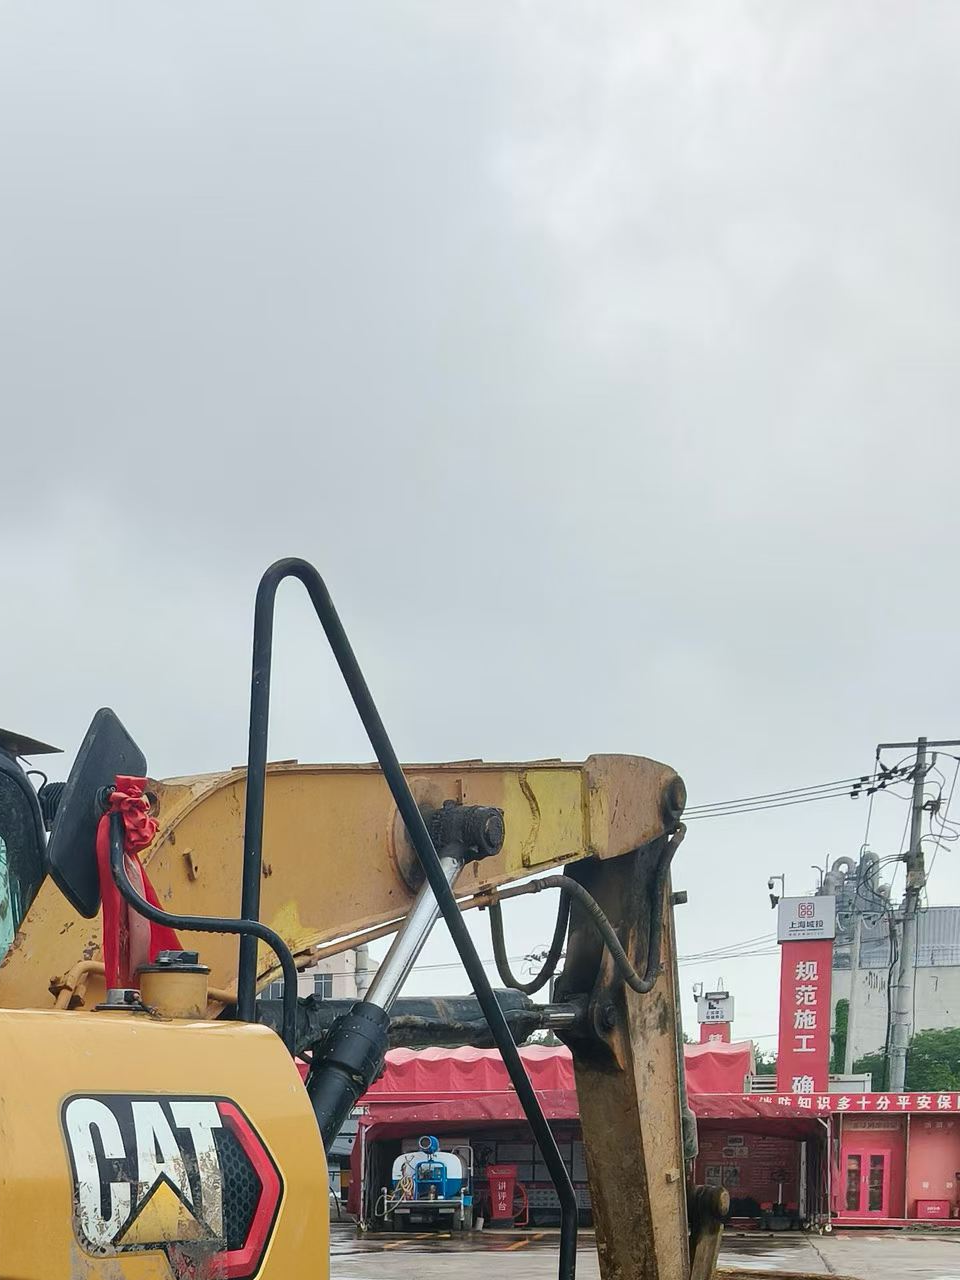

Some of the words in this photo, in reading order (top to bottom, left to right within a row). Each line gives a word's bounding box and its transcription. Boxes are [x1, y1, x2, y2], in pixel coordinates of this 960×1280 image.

[793, 961, 819, 1052] 规范施工
[65, 1097, 226, 1248] CAT
